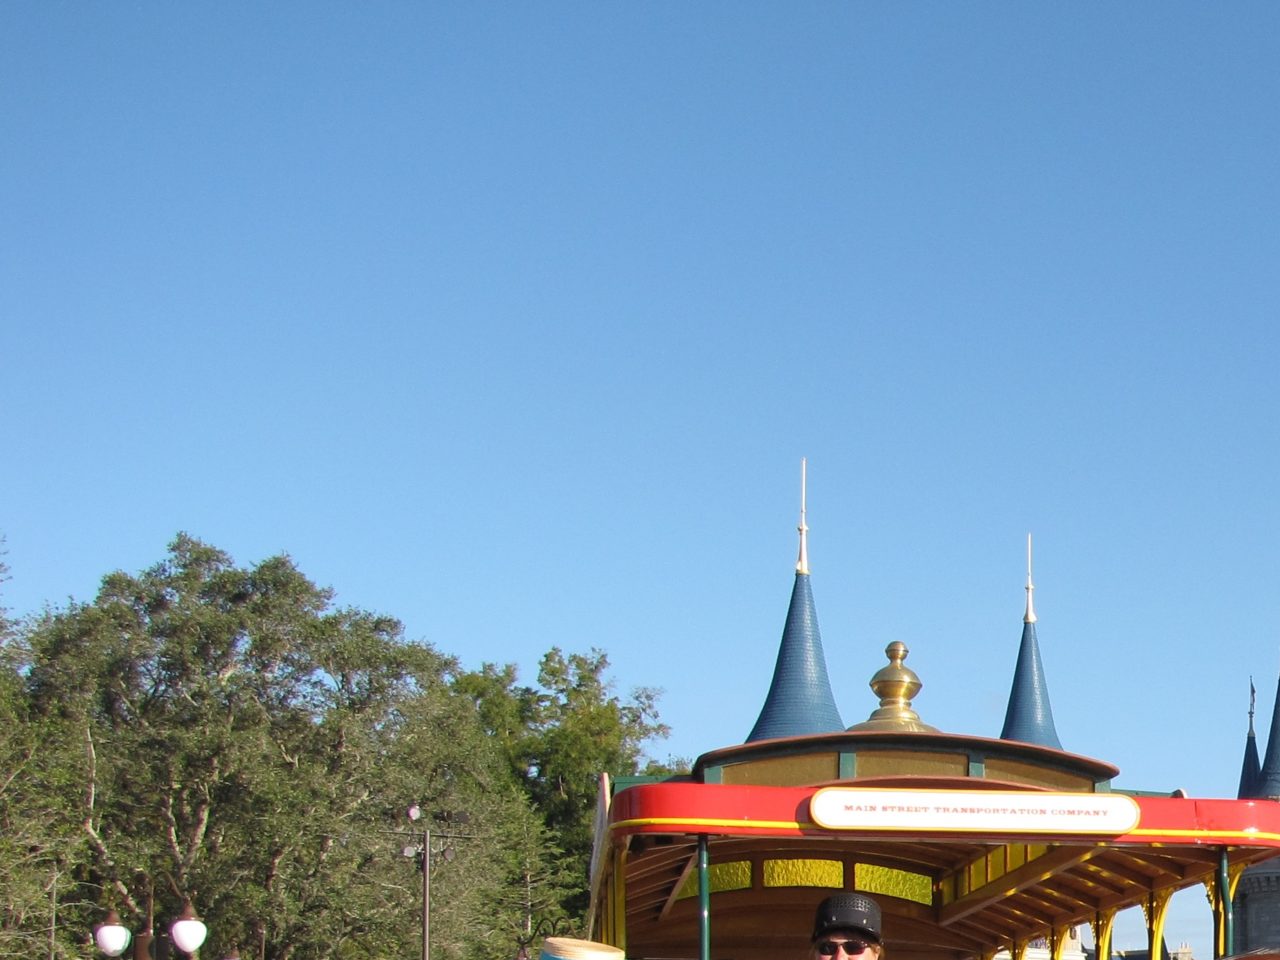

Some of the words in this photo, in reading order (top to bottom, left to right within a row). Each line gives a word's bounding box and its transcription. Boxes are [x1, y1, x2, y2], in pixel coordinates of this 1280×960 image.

[843, 804, 878, 812] MAIN
[881, 805, 930, 813] STREET
[933, 806, 1047, 815] TRANSPORTATION
[1050, 808, 1109, 817] COMPANY
